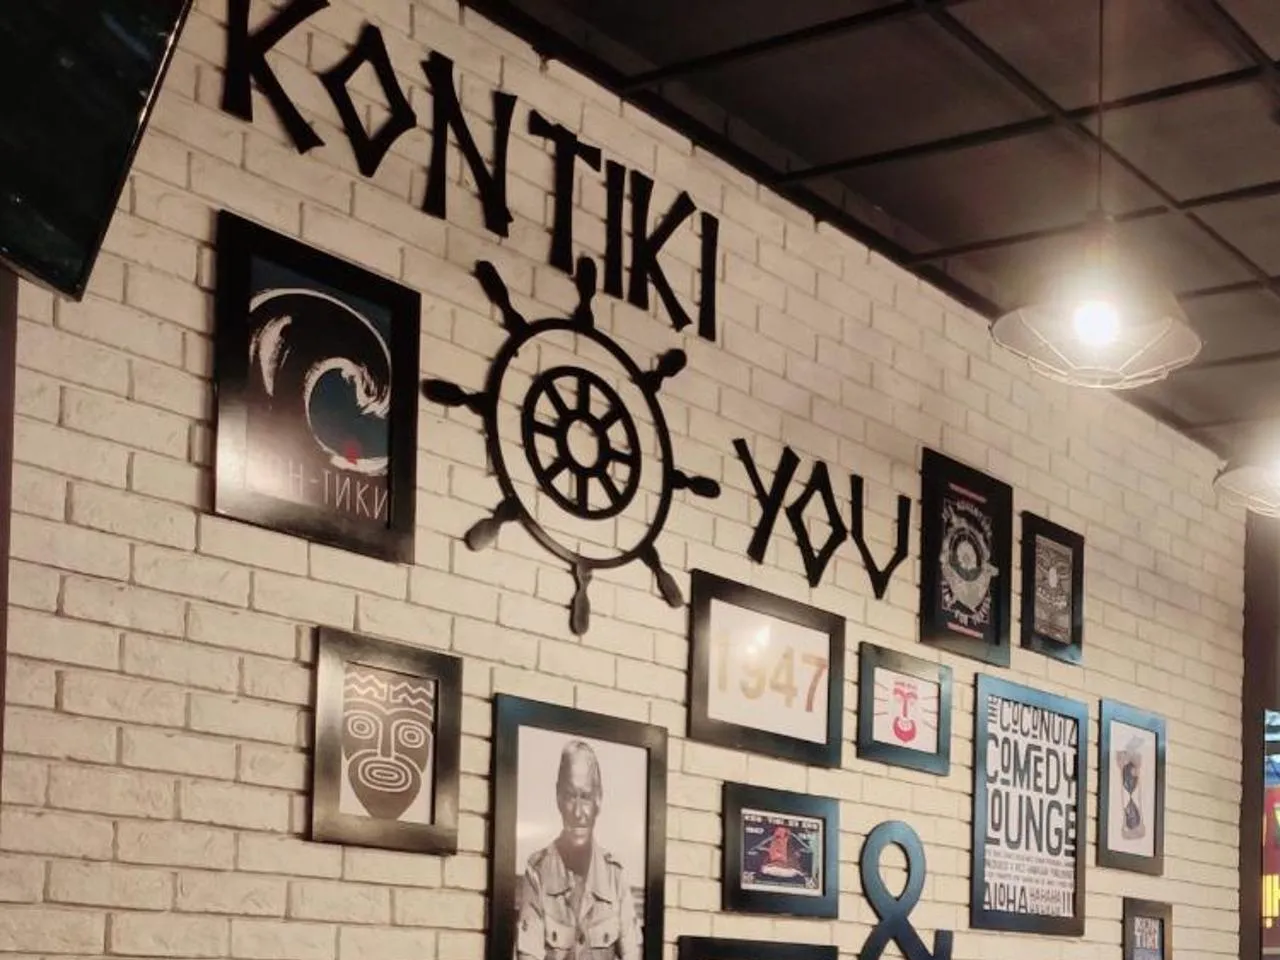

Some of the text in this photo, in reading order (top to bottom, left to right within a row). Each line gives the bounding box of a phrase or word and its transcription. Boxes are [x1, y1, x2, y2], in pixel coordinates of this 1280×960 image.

[732, 438, 911, 600] YOU
[714, 632, 829, 713] 1947
[985, 733, 1077, 800] COMEDY
